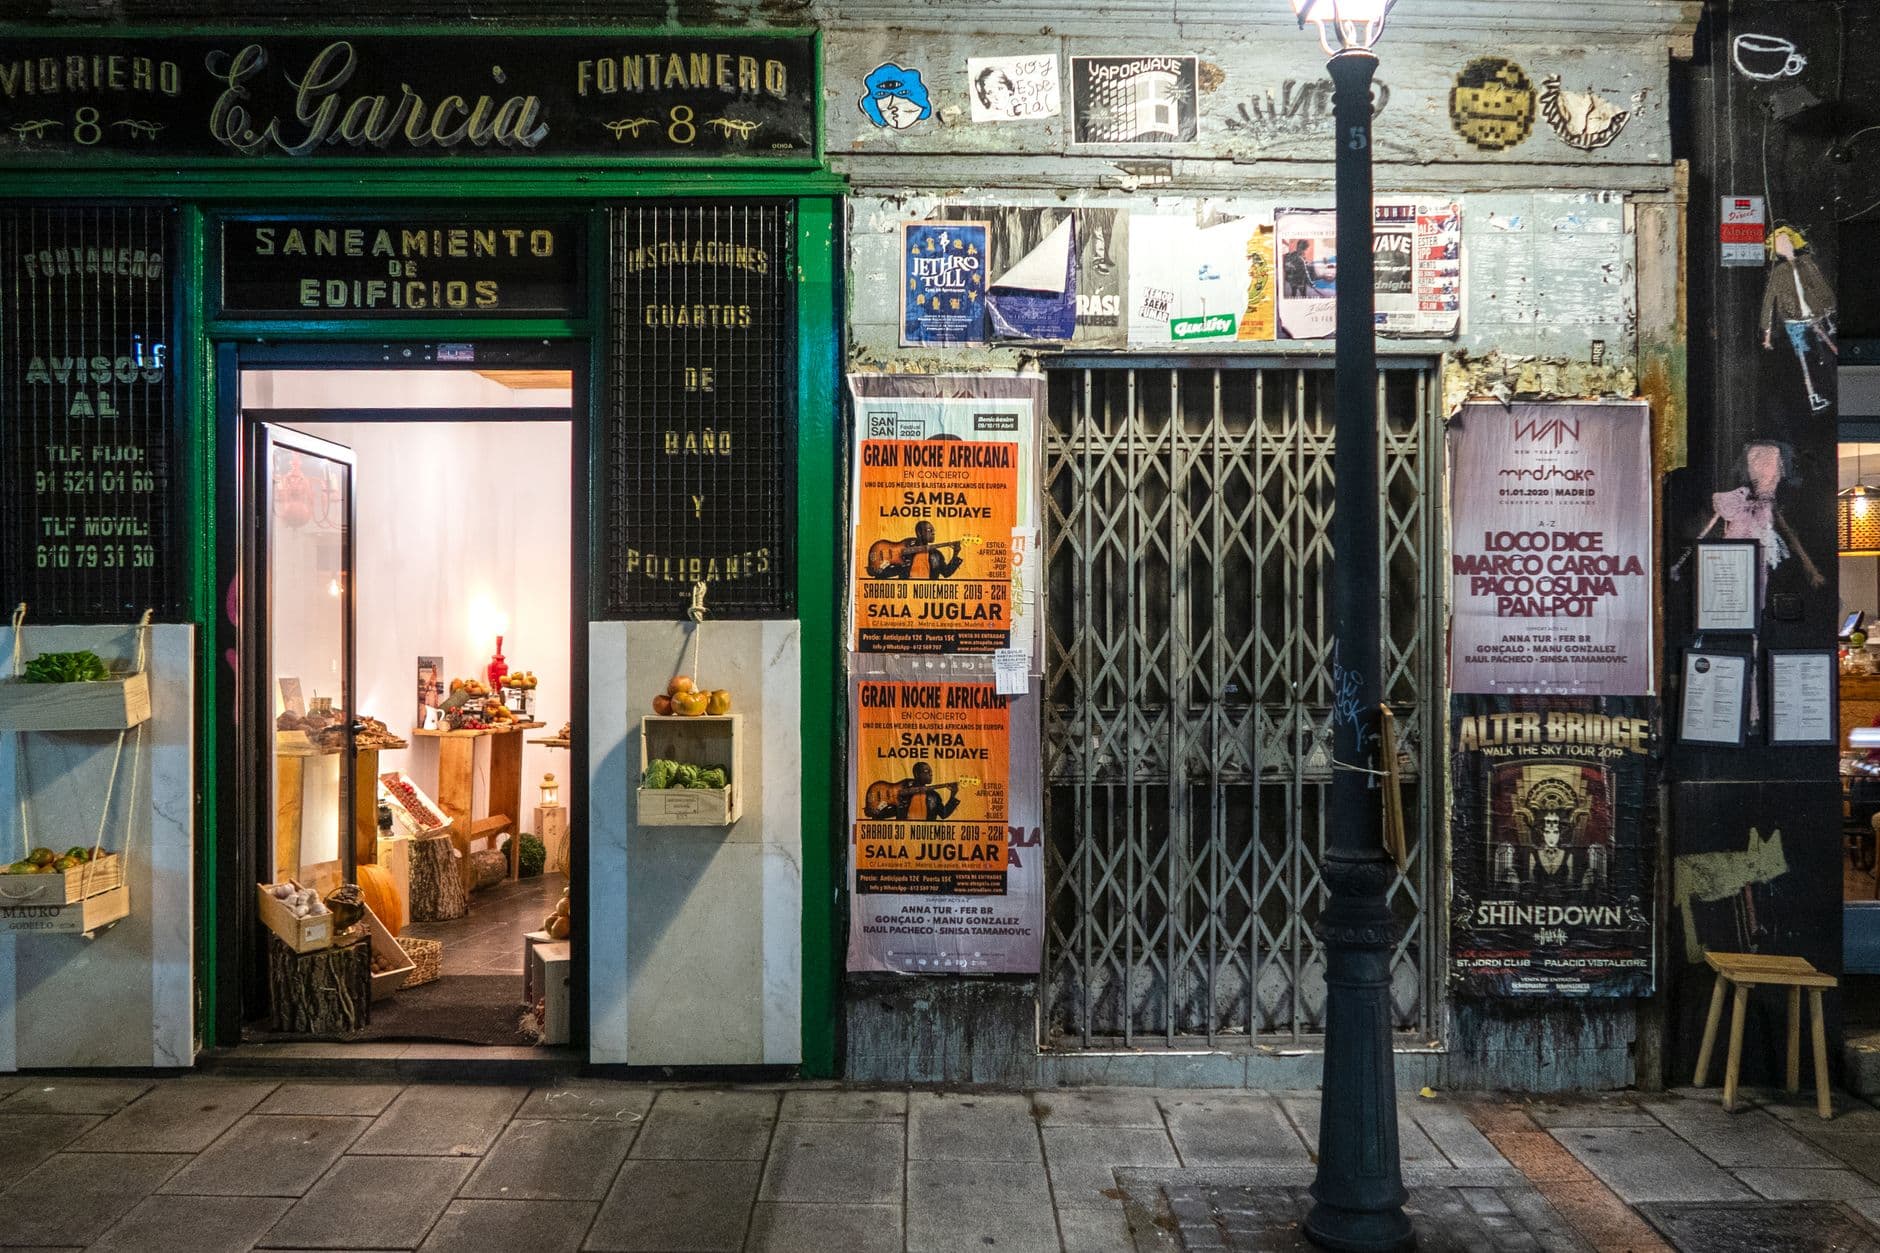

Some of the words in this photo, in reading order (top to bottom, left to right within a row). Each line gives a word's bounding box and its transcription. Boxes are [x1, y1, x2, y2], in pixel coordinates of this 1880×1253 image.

[0, 55, 179, 98] VIDRIERO
[577, 53, 787, 99] FONTANERO
[1089, 58, 1181, 80] VAPORWAVE
[74, 106, 101, 145] 8
[667, 105, 696, 144] 8
[1348, 127, 1367, 150] 5
[256, 227, 554, 257] SANEAMIENTO
[1374, 235, 1412, 254] AVE
[24, 248, 161, 278] FONTANERO
[628, 239, 768, 273] INSTALACIONES
[912, 255, 979, 276] JETHRO
[389, 259, 417, 277] DE
[921, 269, 966, 287] TULL
[301, 278, 499, 310] EDIFICIOS
[645, 303, 752, 329] CUARTOS
[1175, 318, 1232, 337] Quality
[25, 356, 164, 384] AVISOS
[684, 367, 714, 392] DE
[70, 391, 119, 418] AL
[871, 417, 894, 426] SAN
[871, 427, 894, 436] SAN
[664, 427, 731, 456] BAÑO
[92, 446, 145, 462] FIJO:
[864, 444, 898, 467] GRAN
[904, 444, 944, 468] NOCHE
[949, 445, 1009, 468] AFRICANA
[36, 471, 56, 495] 91
[63, 471, 94, 494] 521
[102, 471, 125, 494] 01
[904, 471, 914, 479] EN
[917, 471, 970, 479] CONCIERTO
[904, 492, 967, 505] SAMBA
[1499, 489, 1549, 497] 01.01.2020
[1555, 489, 1595, 497] MADRID
[692, 494, 704, 519] Y
[880, 507, 931, 518] LAOBE
[936, 507, 991, 518] NDIAYE
[1485, 531, 1550, 552] LOCO
[1552, 531, 1603, 552] DICE
[36, 545, 69, 568] 610
[75, 545, 98, 568] 79
[104, 545, 124, 568] 31
[133, 545, 155, 568] 30
[627, 547, 769, 583] POLIBANES
[1453, 554, 1543, 575] MARCO
[1547, 555, 1644, 576] CAROLA
[864, 583, 896, 599] SABADO
[898, 583, 908, 599] 30
[913, 584, 958, 600] NOVIEMBRE
[964, 584, 983, 600] 2019
[991, 585, 1007, 600] 22H
[1471, 576, 1534, 596] PACO
[1536, 576, 1618, 596] OSUNA
[868, 604, 911, 617] SALA
[918, 603, 1002, 621] JUGLAR
[1498, 597, 1599, 618] PAN-POT
[1502, 635, 1530, 643] ANNA
[1533, 635, 1551, 643] TUR
[1559, 635, 1575, 643] FER
[1578, 635, 1591, 643] BR
[1476, 645, 1524, 656] GONÇALO
[1533, 645, 1562, 653] MANU
[1565, 645, 1616, 653] GONZALEZ
[862, 685, 896, 708] GRAN
[901, 686, 940, 709] NOCHE
[946, 687, 1007, 710] AFRICANA
[901, 712, 912, 720] EN
[915, 712, 967, 721] CONCIERTO
[901, 733, 964, 746] SAMBA
[1458, 712, 1541, 753] ALTER
[1545, 711, 1649, 755] BRIDGE
[878, 748, 928, 759] LAOBE
[934, 748, 988, 760] NDIAYE
[1483, 746, 1514, 756] WALK
[1517, 745, 1539, 755] THE
[1541, 745, 1562, 755] SKY
[1565, 746, 1595, 756] TOUR
[1598, 747, 1623, 757] 2019
[861, 824, 893, 840] SABADO
[895, 824, 905, 840] 30
[910, 824, 955, 841] NOVIEMBRE
[961, 825, 979, 841] 2019
[988, 826, 1004, 841] 22H
[865, 845, 908, 859] SALA
[915, 844, 999, 861] JUGLAR
[875, 916, 925, 926] GONÇALO
[966, 917, 1019, 925] GONZALEZ
[1477, 905, 1621, 925] SHINEDOWN
[971, 928, 1032, 936] TAMAMOVIC
[1473, 959, 1502, 967] JORDI
[1503, 959, 1531, 967] CLUB
[1544, 959, 1586, 967] PALACIO
[1587, 959, 1648, 967] VISTALEGRE
